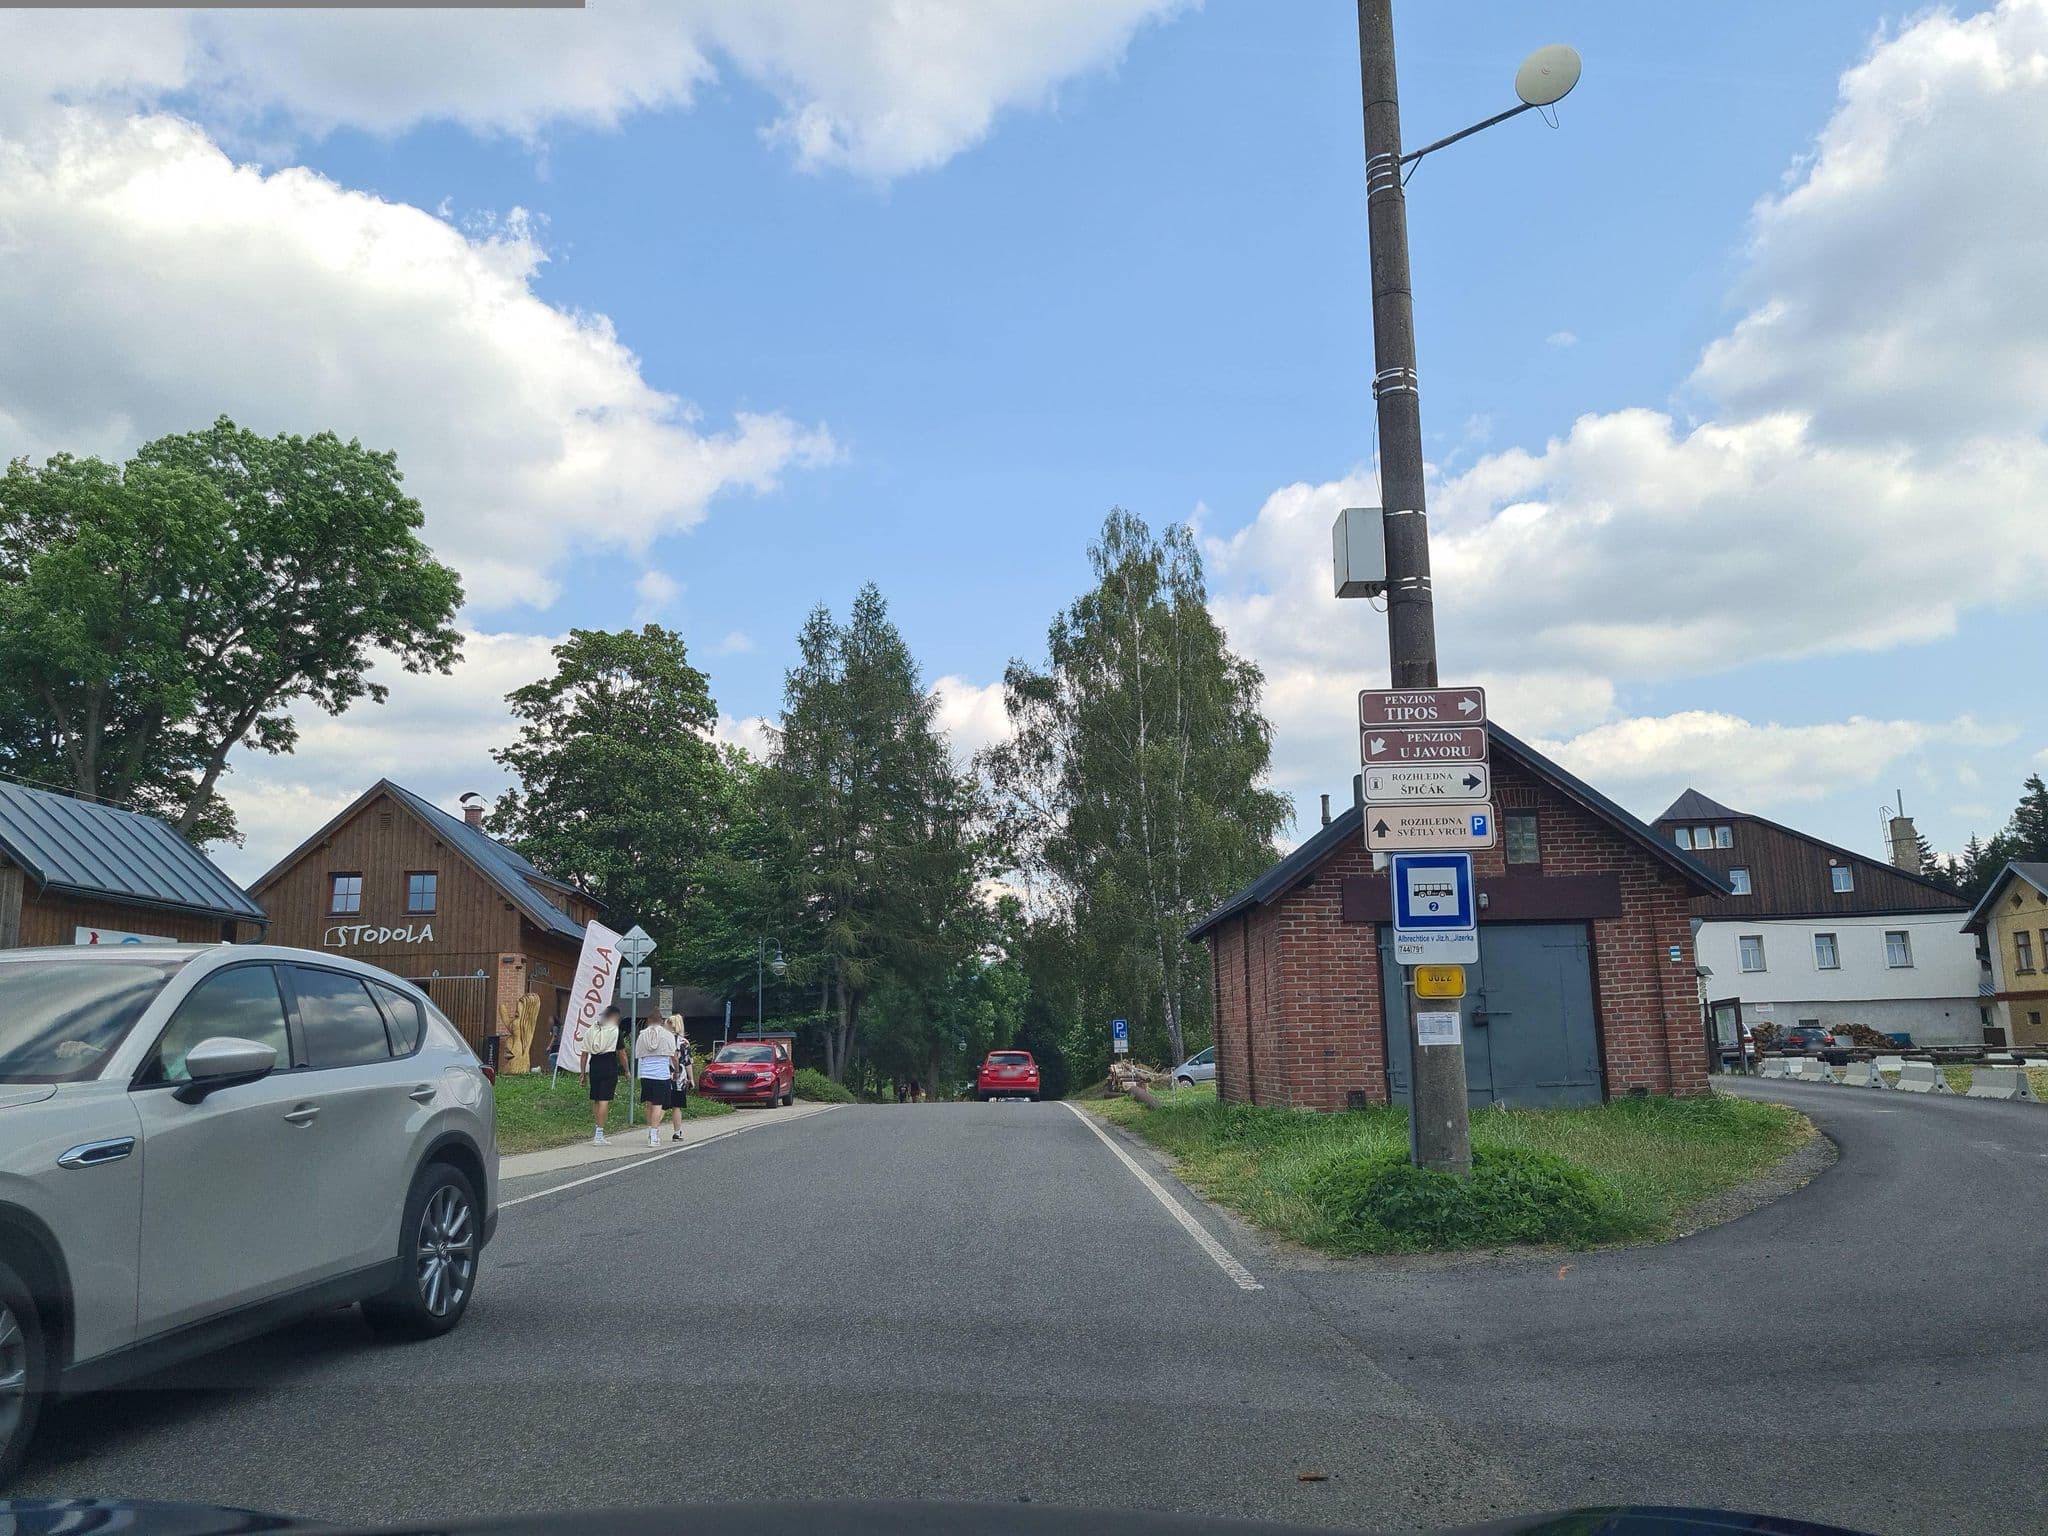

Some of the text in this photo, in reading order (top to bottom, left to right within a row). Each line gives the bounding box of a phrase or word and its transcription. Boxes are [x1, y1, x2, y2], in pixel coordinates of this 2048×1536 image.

[1384, 695, 1436, 704] PENZION
[1384, 706, 1438, 720] TIPOS
[1407, 733, 1462, 743] PENZION
[1400, 746, 1471, 758] U JAVORU
[1392, 773, 1453, 781] ROZHLEDNA
[1401, 783, 1445, 795] ŠPIČÁK
[1401, 817, 1463, 826] ROZHLEDNA
[1473, 817, 1484, 831] P
[1397, 826, 1467, 837] SVĚTLÝ VRCH
[1431, 902, 1437, 911] 2
[337, 923, 434, 947] STODOLA
[1398, 934, 1430, 943] Albrechtice
[1116, 1022, 1124, 1033] P
